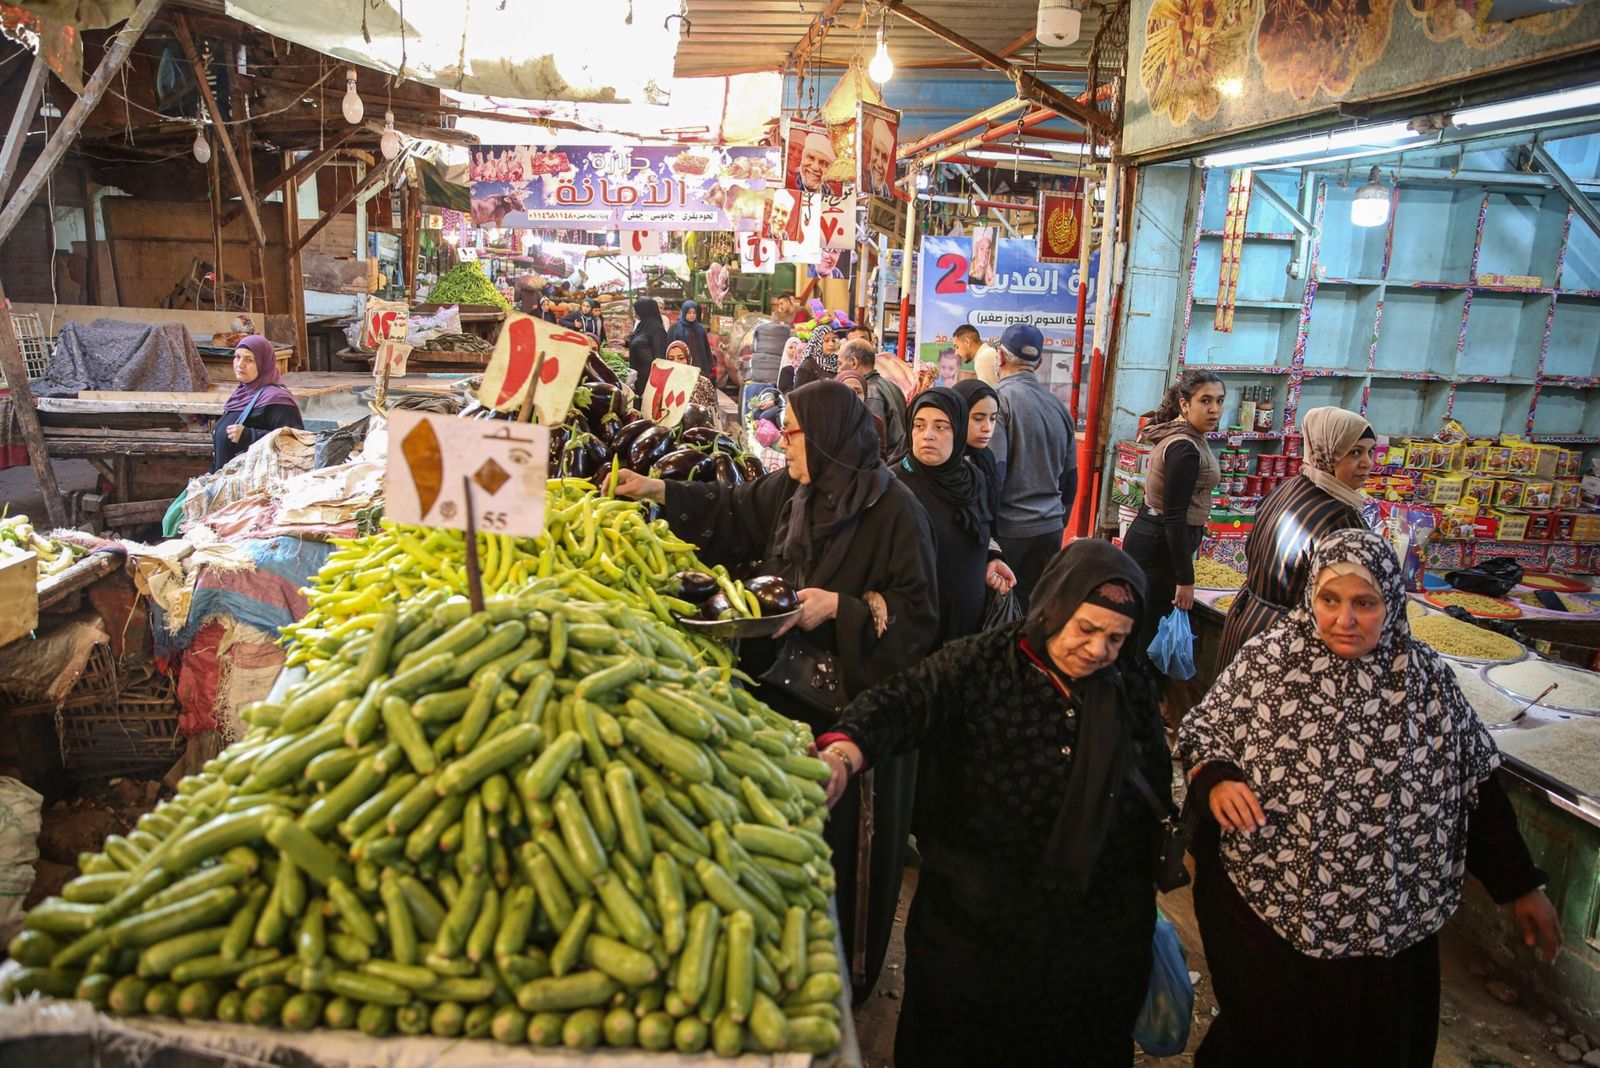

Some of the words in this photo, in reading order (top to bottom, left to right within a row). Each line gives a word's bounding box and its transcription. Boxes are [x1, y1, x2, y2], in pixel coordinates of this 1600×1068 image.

[591, 152, 651, 175] جزارة
[820, 216, 844, 246] ٧٠
[935, 253, 968, 294] 2
[1034, 313, 1064, 325] اللحوم
[482, 511, 508, 530] 55
